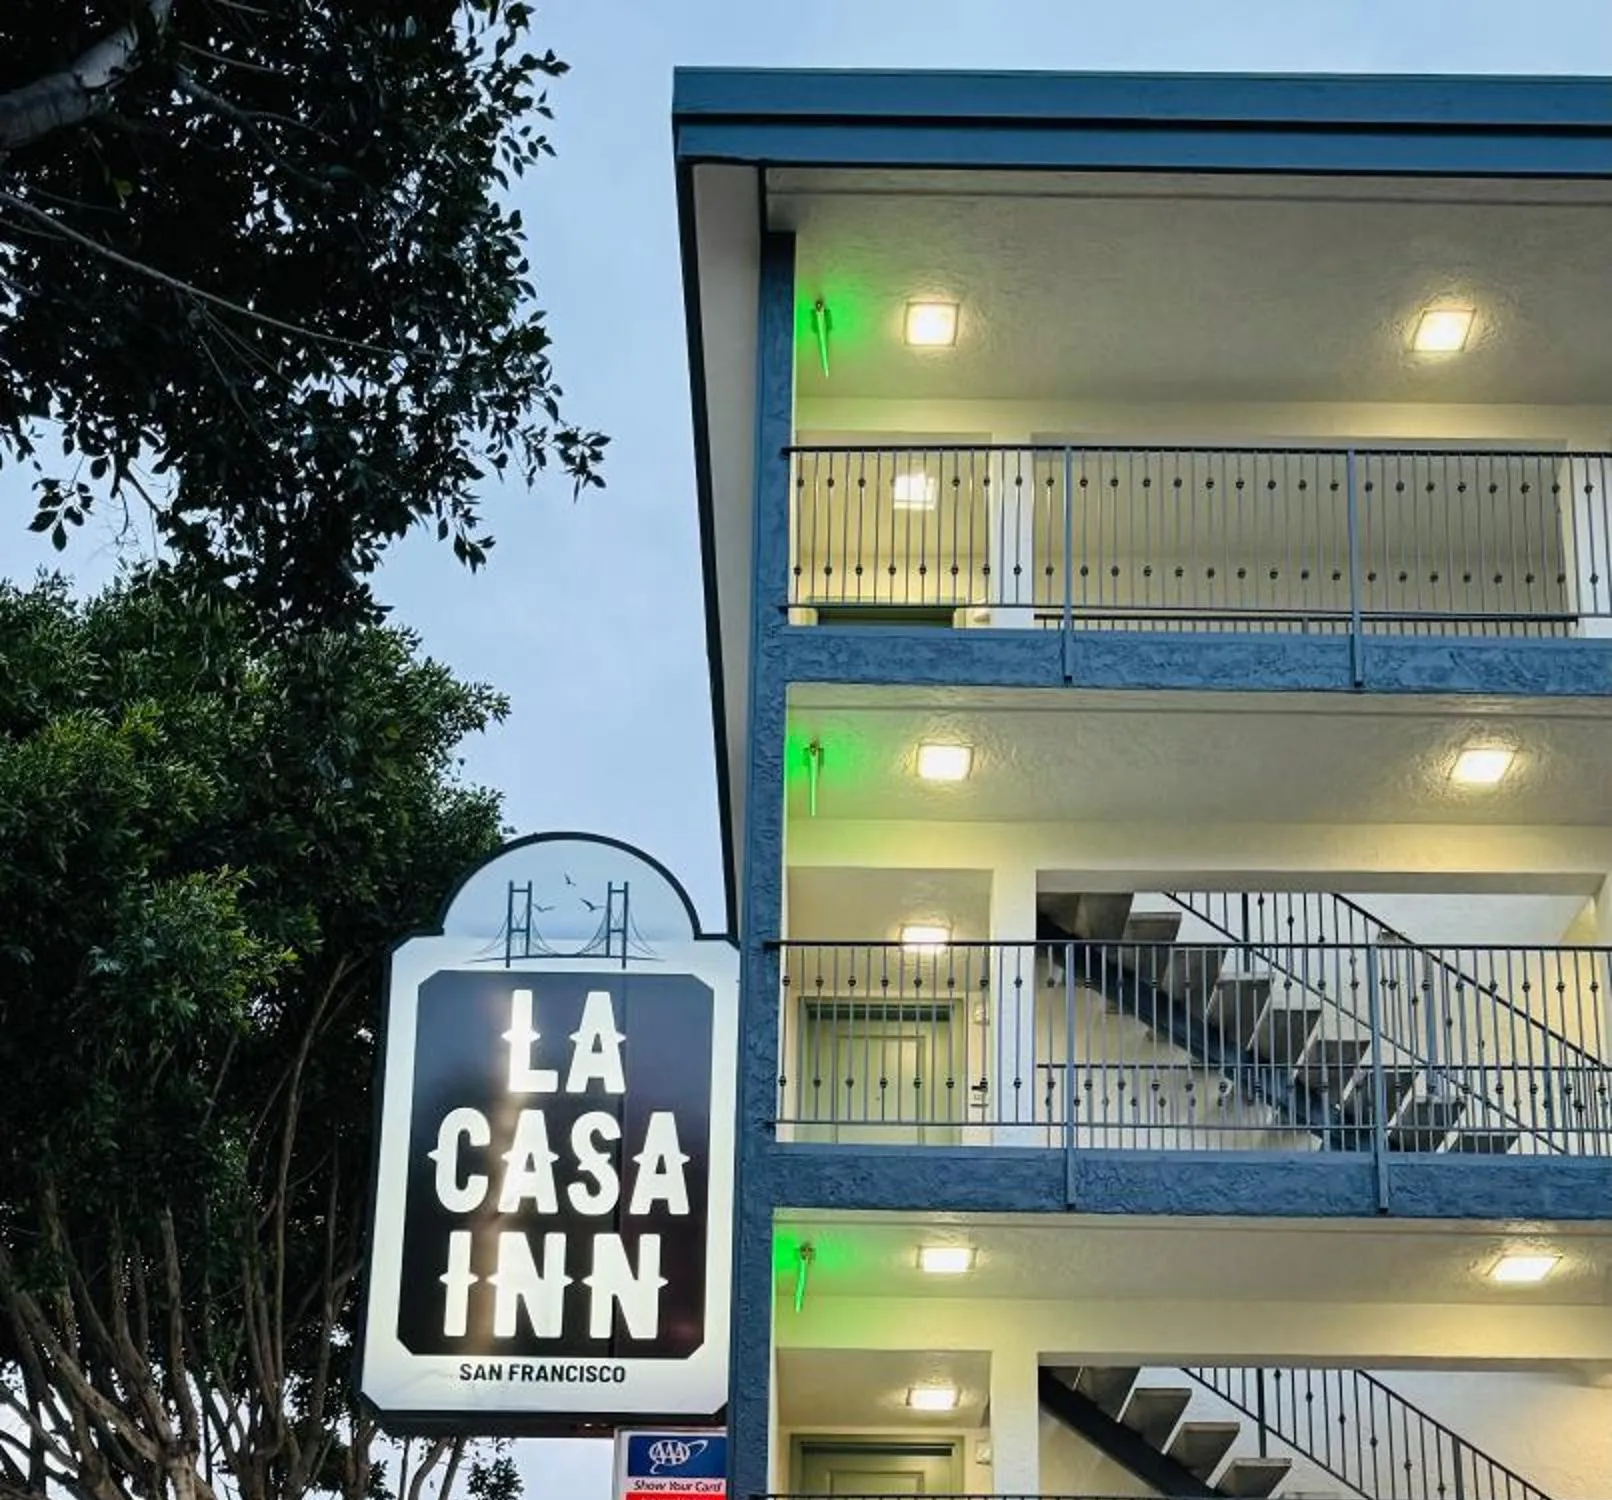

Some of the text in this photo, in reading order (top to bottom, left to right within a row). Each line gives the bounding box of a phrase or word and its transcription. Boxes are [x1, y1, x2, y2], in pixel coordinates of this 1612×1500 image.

[501, 989, 626, 1094] LA
[427, 1107, 691, 1215] CASA
[440, 1231, 669, 1340] INN
[459, 1363, 626, 1383] SAN FRANCISCO
[651, 1440, 689, 1465] AAA
[634, 1480, 722, 1492] Show Your Card
